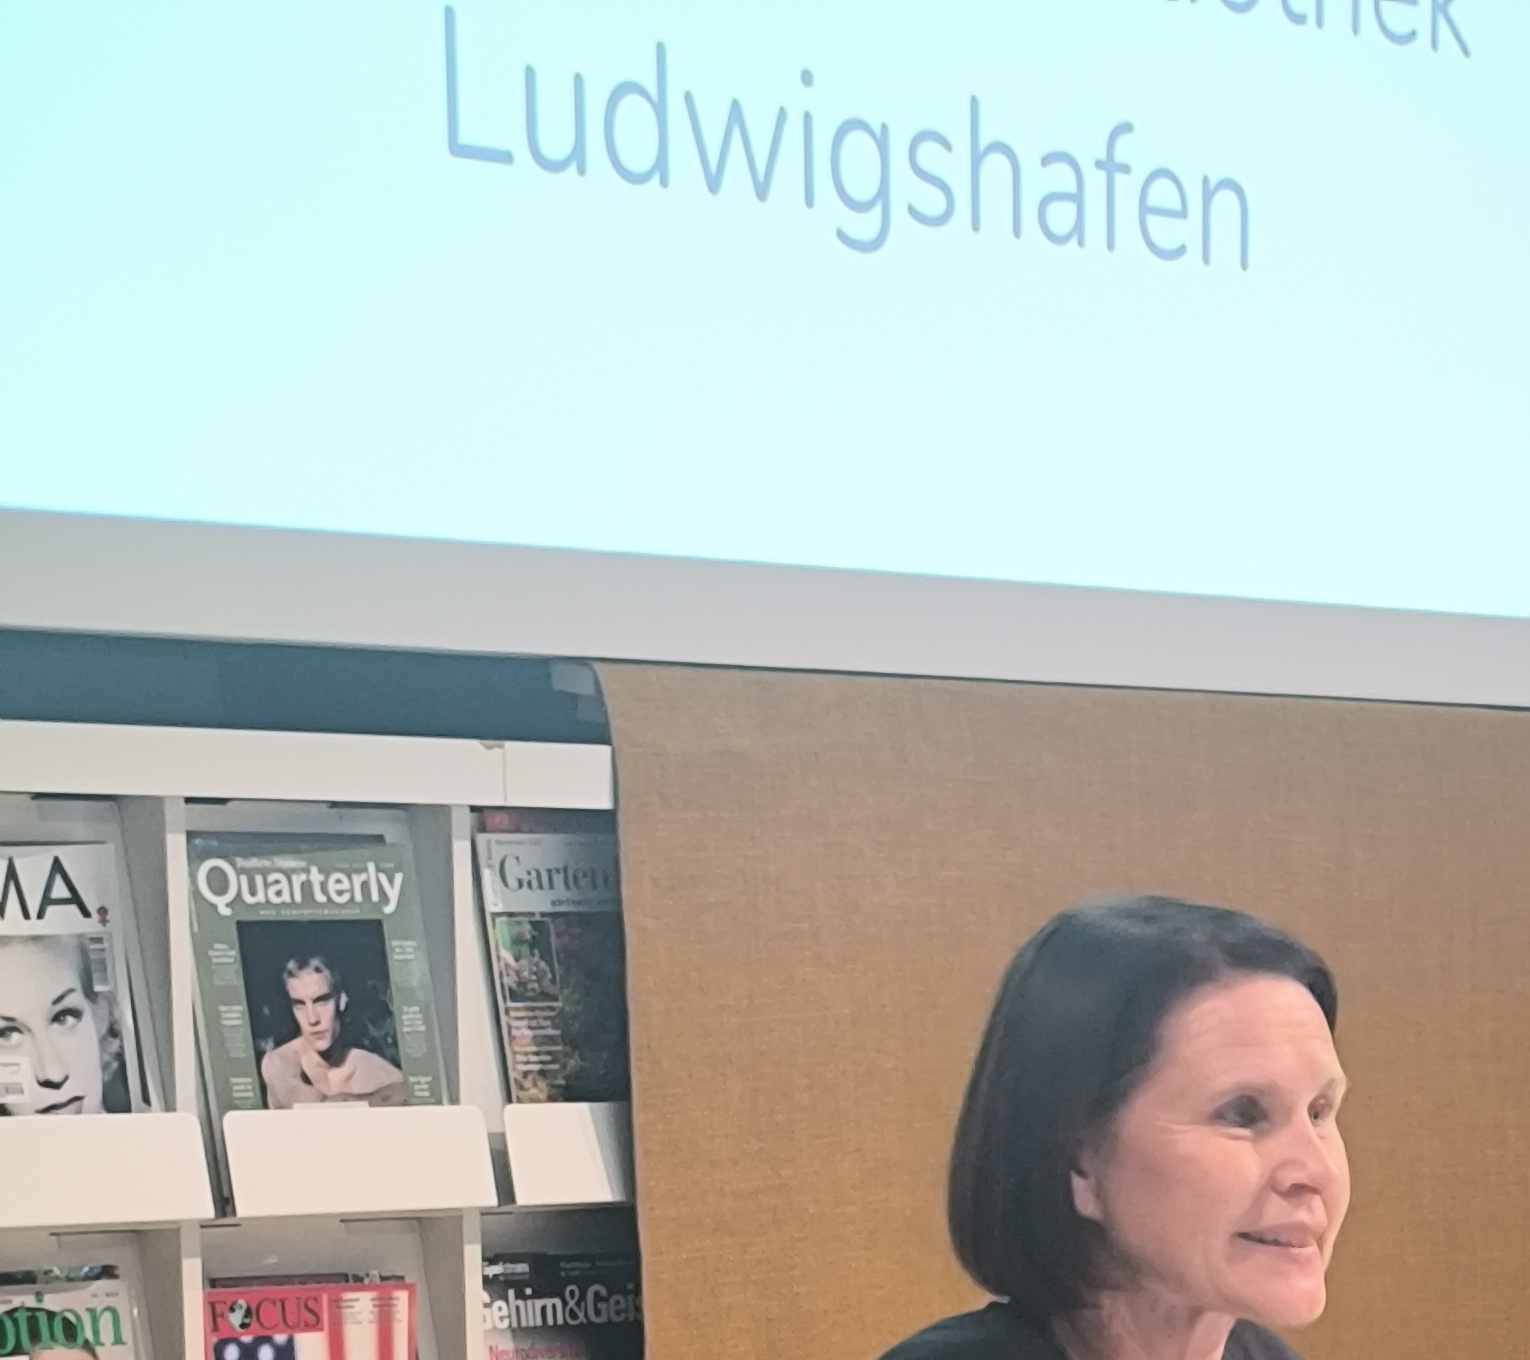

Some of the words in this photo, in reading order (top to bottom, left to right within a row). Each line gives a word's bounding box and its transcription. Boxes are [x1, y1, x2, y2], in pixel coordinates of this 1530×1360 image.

[443, 4, 1250, 271] Ludwigshafen
[197, 858, 404, 916] Quarterly
[499, 853, 611, 893] Garten
